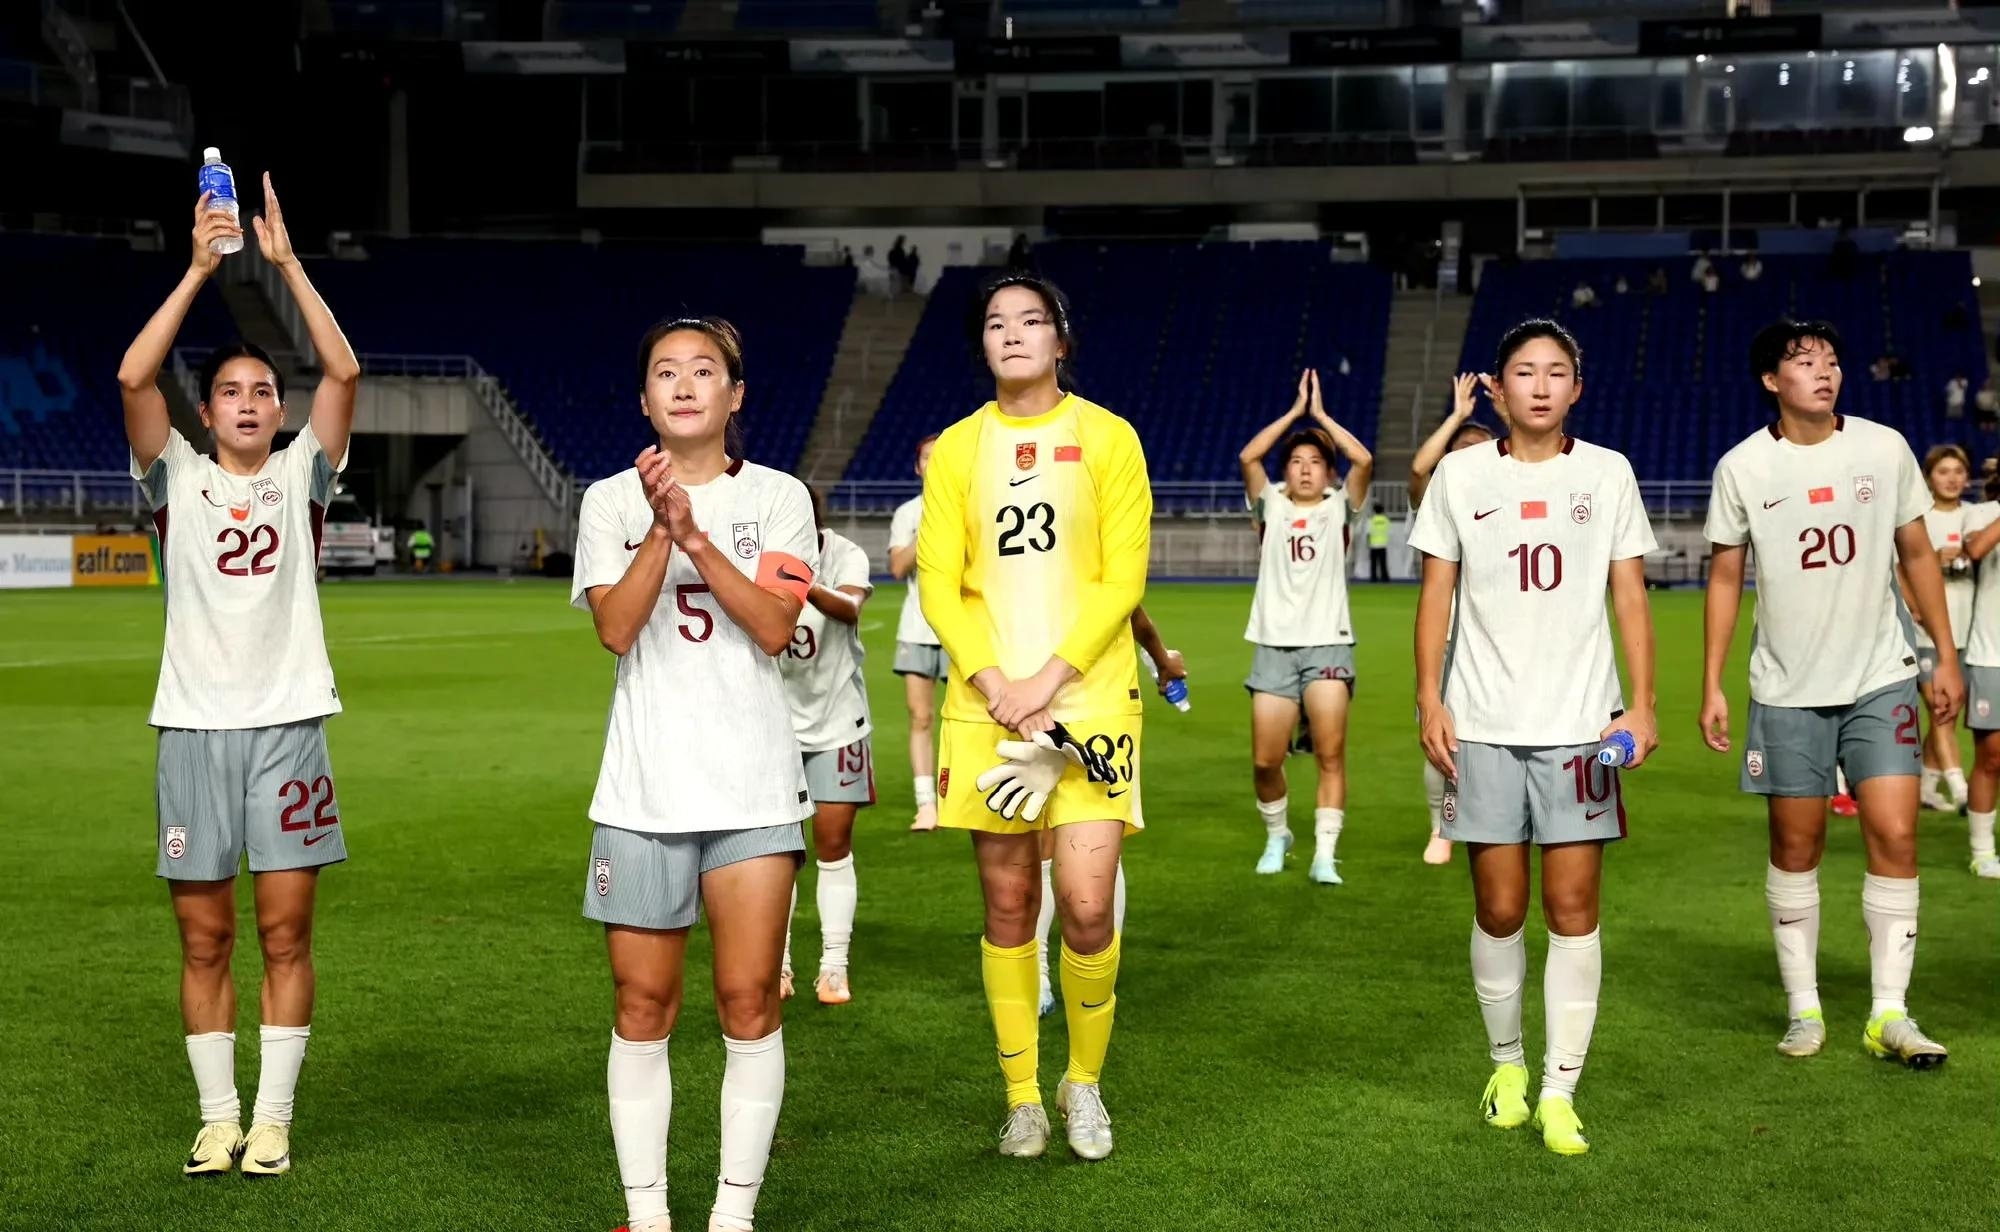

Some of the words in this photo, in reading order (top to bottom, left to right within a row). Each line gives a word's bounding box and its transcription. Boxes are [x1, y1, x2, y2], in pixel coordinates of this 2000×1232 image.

[216, 524, 279, 576] 22
[996, 502, 1056, 556] 23
[1287, 535, 1315, 562] 16
[1798, 523, 1856, 570] 20
[77, 547, 147, 573] eaff.com
[1508, 543, 1562, 592] 10
[676, 584, 714, 643] 5
[1891, 704, 1919, 745] 2
[837, 740, 864, 773] 19
[1562, 755, 1611, 803] 10
[278, 775, 338, 832] 22
